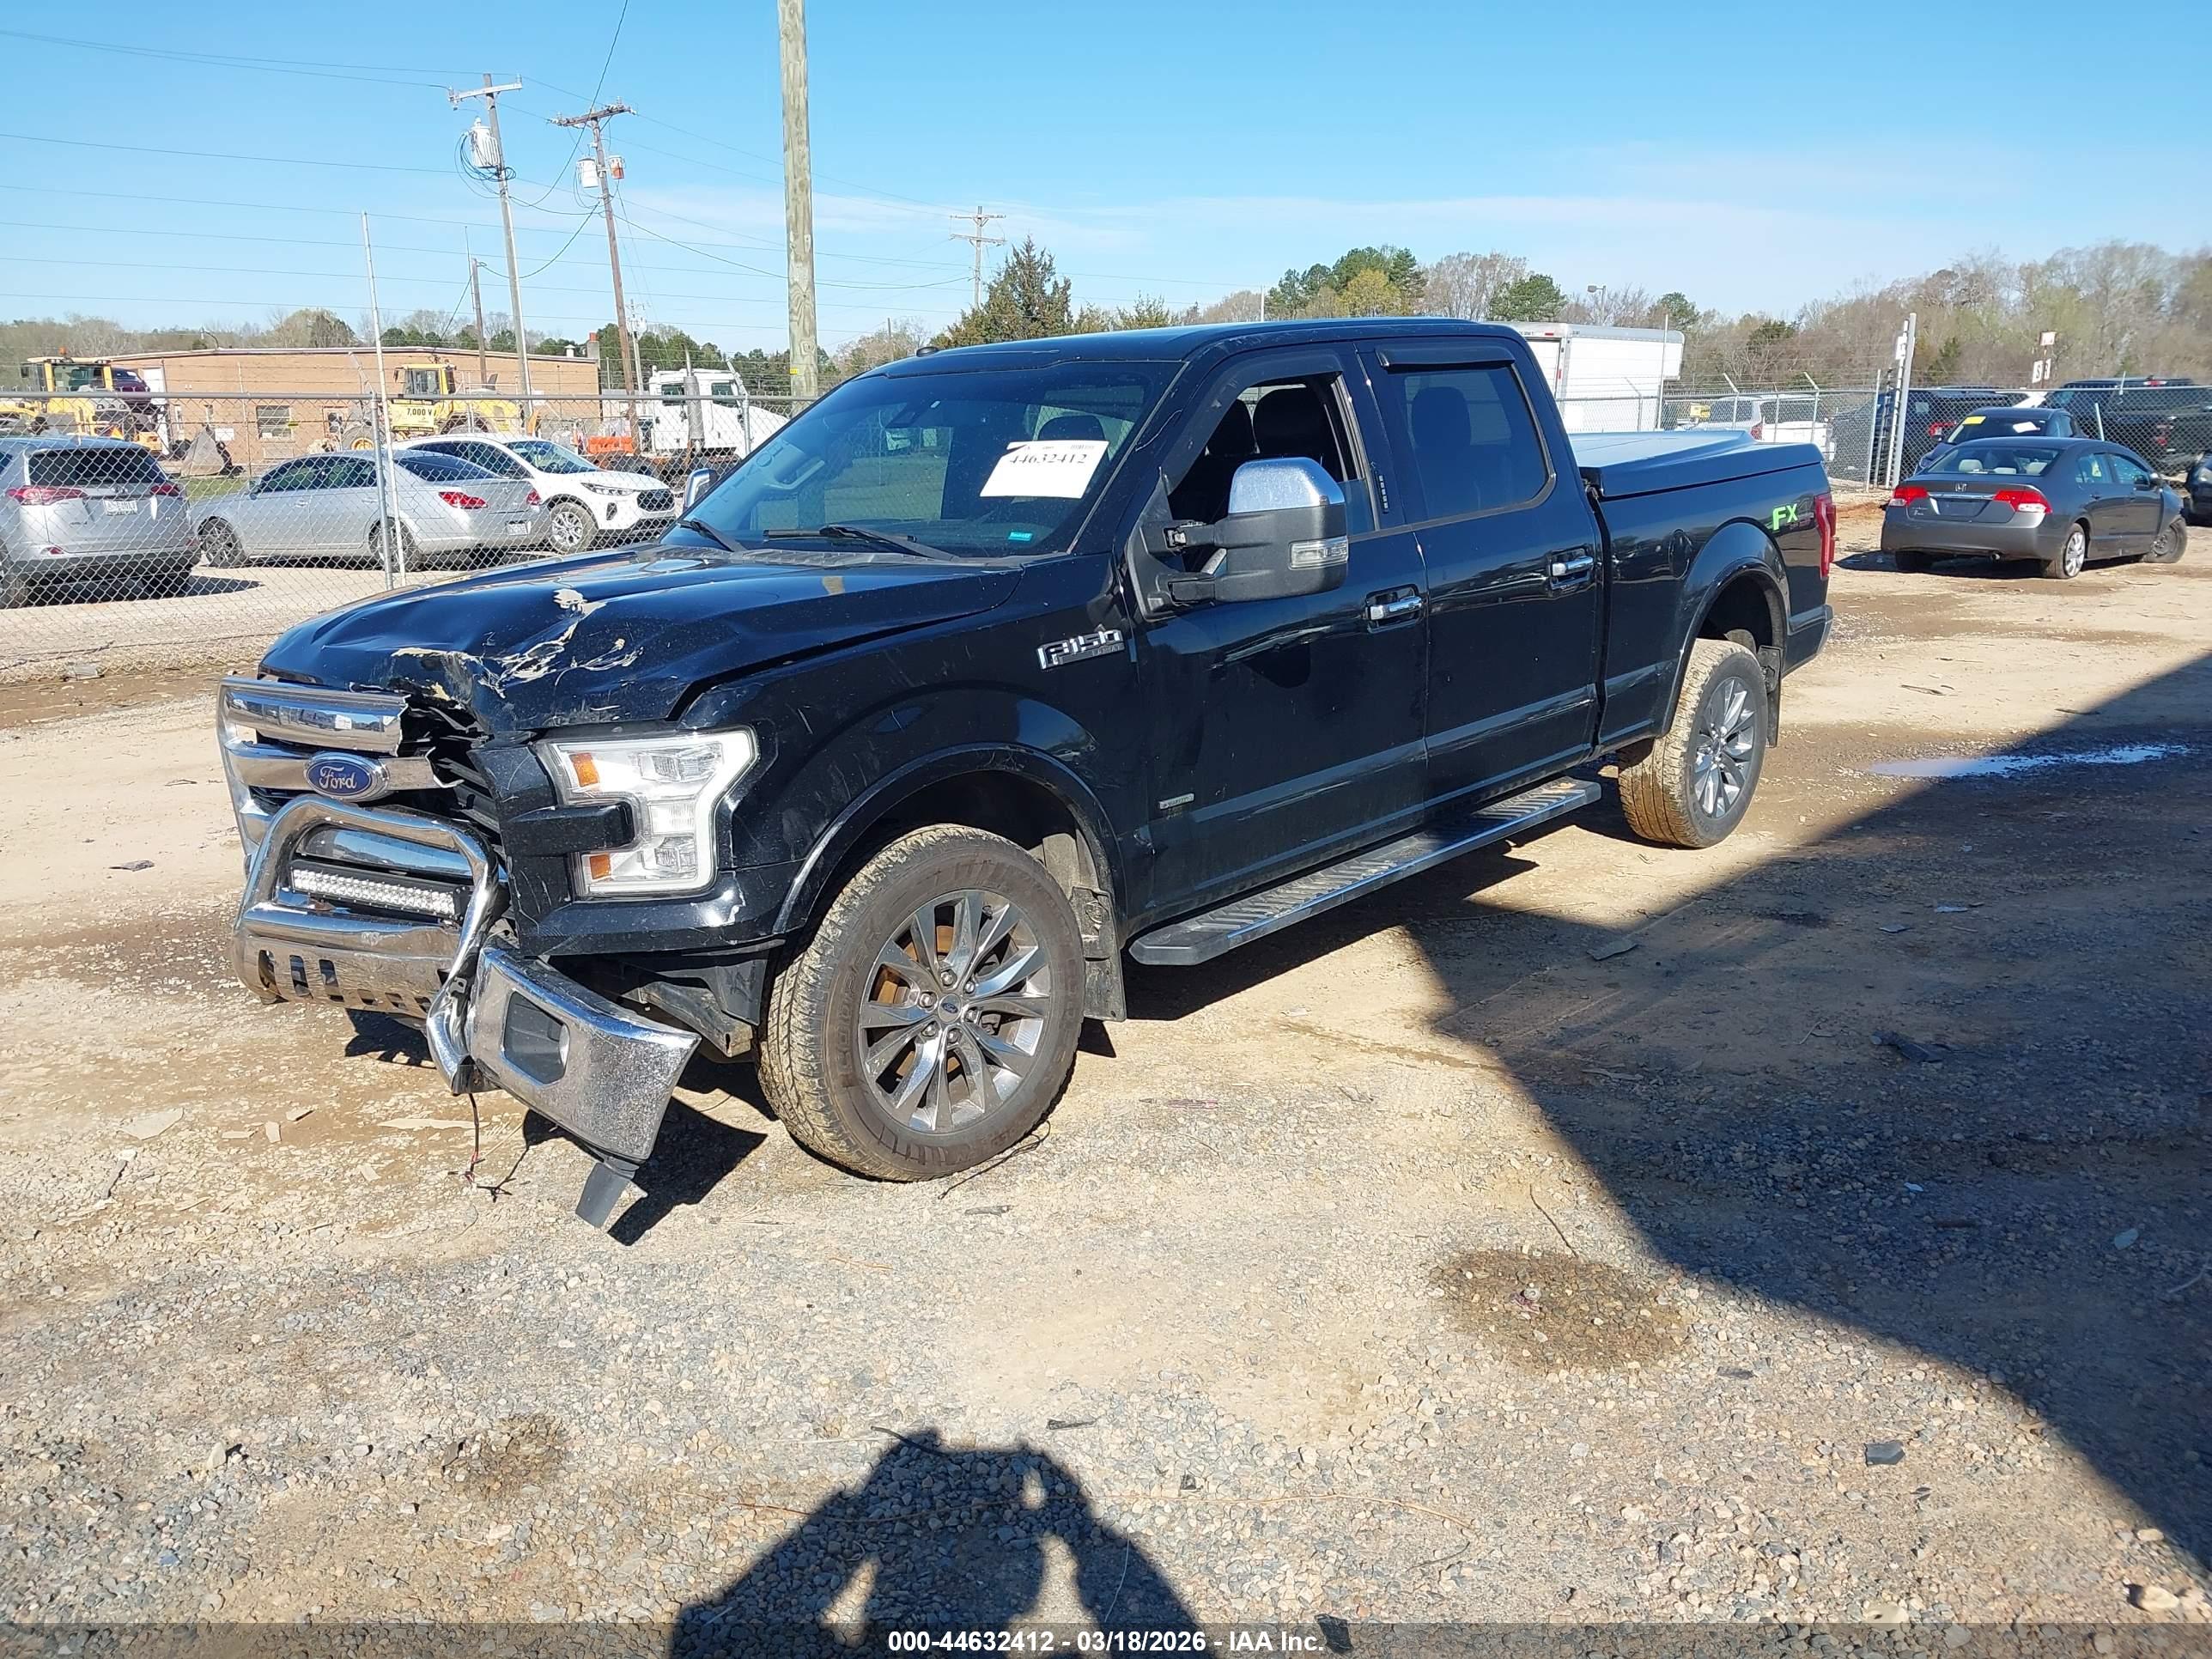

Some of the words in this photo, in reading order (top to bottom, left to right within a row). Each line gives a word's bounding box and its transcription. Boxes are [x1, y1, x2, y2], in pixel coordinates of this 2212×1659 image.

[1010, 453, 1088, 464] 44632412
[1772, 503, 1798, 531] FX
[319, 765, 357, 789] Ford
